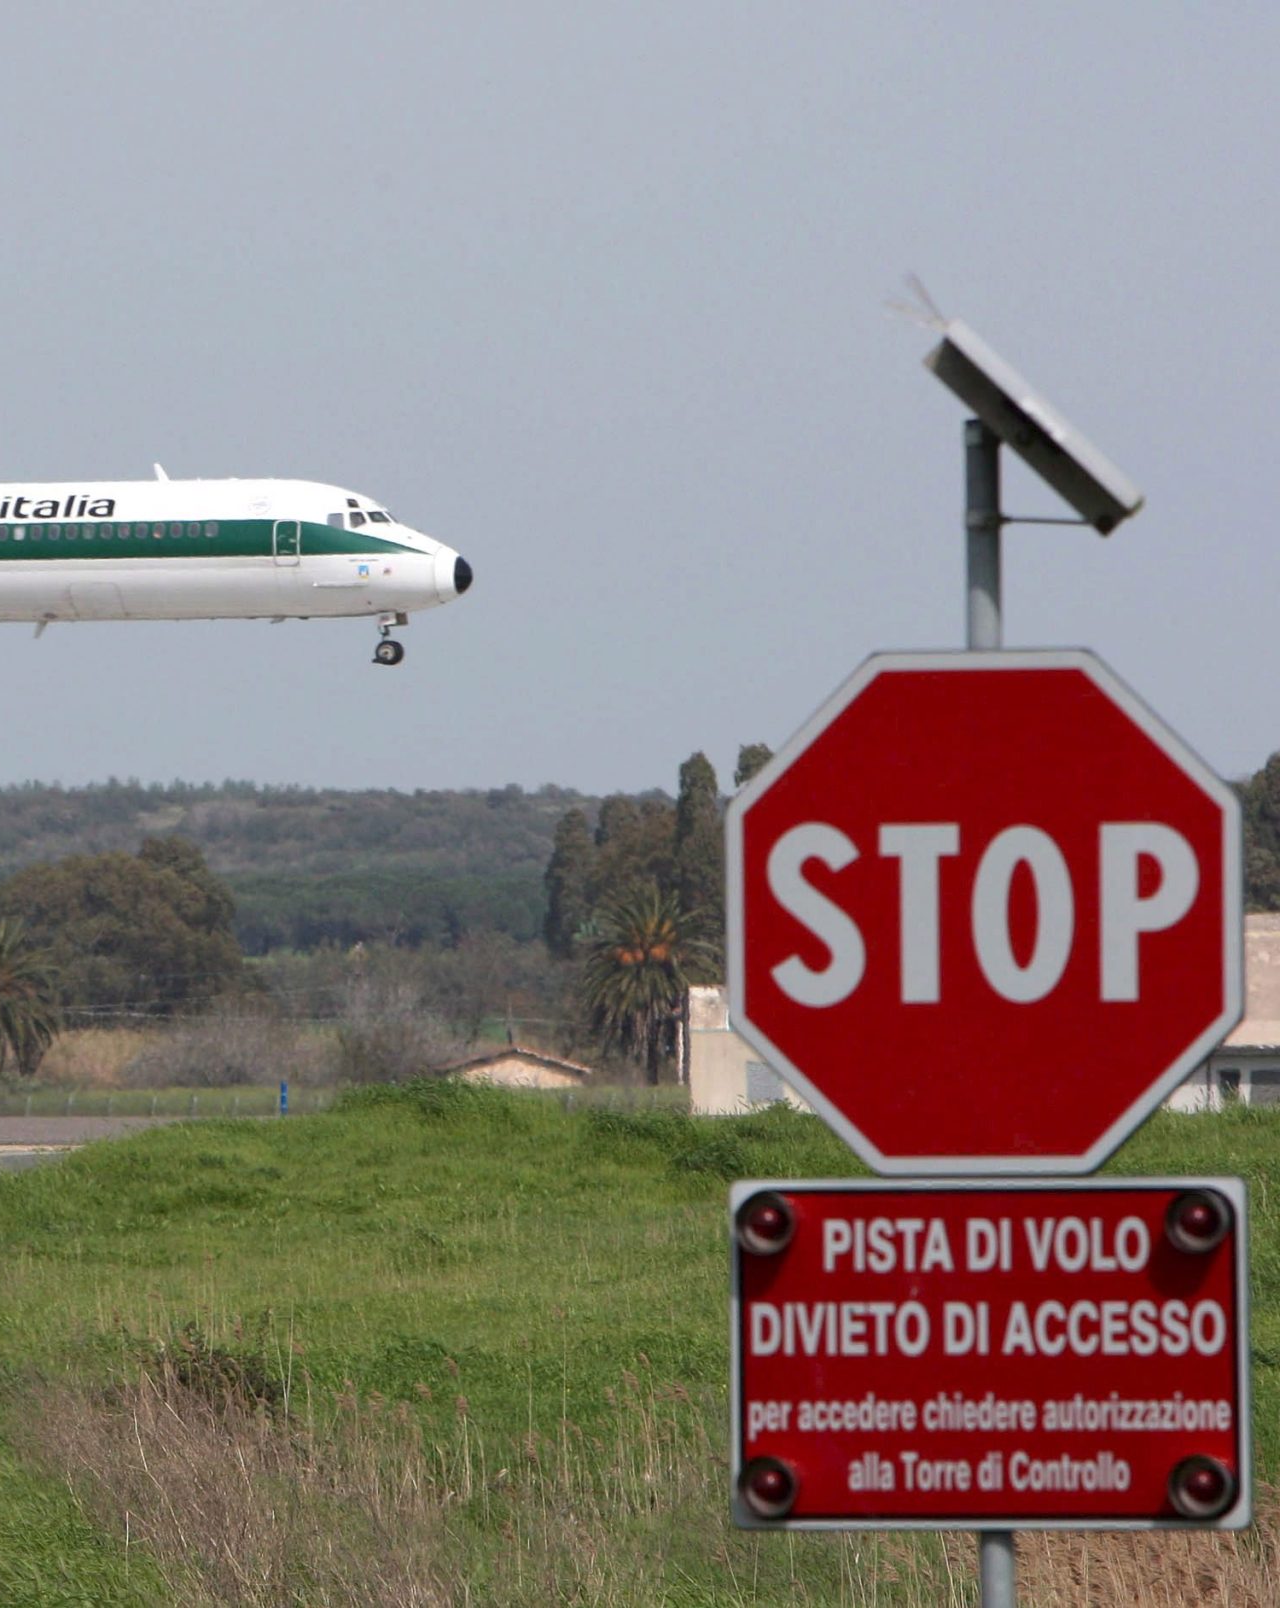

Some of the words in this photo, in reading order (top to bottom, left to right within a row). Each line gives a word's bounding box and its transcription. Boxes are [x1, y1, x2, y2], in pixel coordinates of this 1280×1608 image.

[767, 822, 1199, 1008] STOP
[824, 1218, 953, 1272] PISTA
[967, 1218, 1011, 1271] DI
[1025, 1217, 1149, 1272] VOLO
[751, 1301, 929, 1356] DIVIETO
[944, 1302, 988, 1354] DI
[1003, 1300, 1225, 1355] ACCESSO
[749, 1402, 791, 1440] per
[798, 1393, 916, 1430] accedere
[924, 1393, 1036, 1430] chiedere
[1043, 1393, 1231, 1430] autorizzazione
[849, 1453, 894, 1490] alla
[901, 1452, 971, 1490] Torre
[978, 1453, 1002, 1490] di
[1010, 1452, 1129, 1490] Controllo
